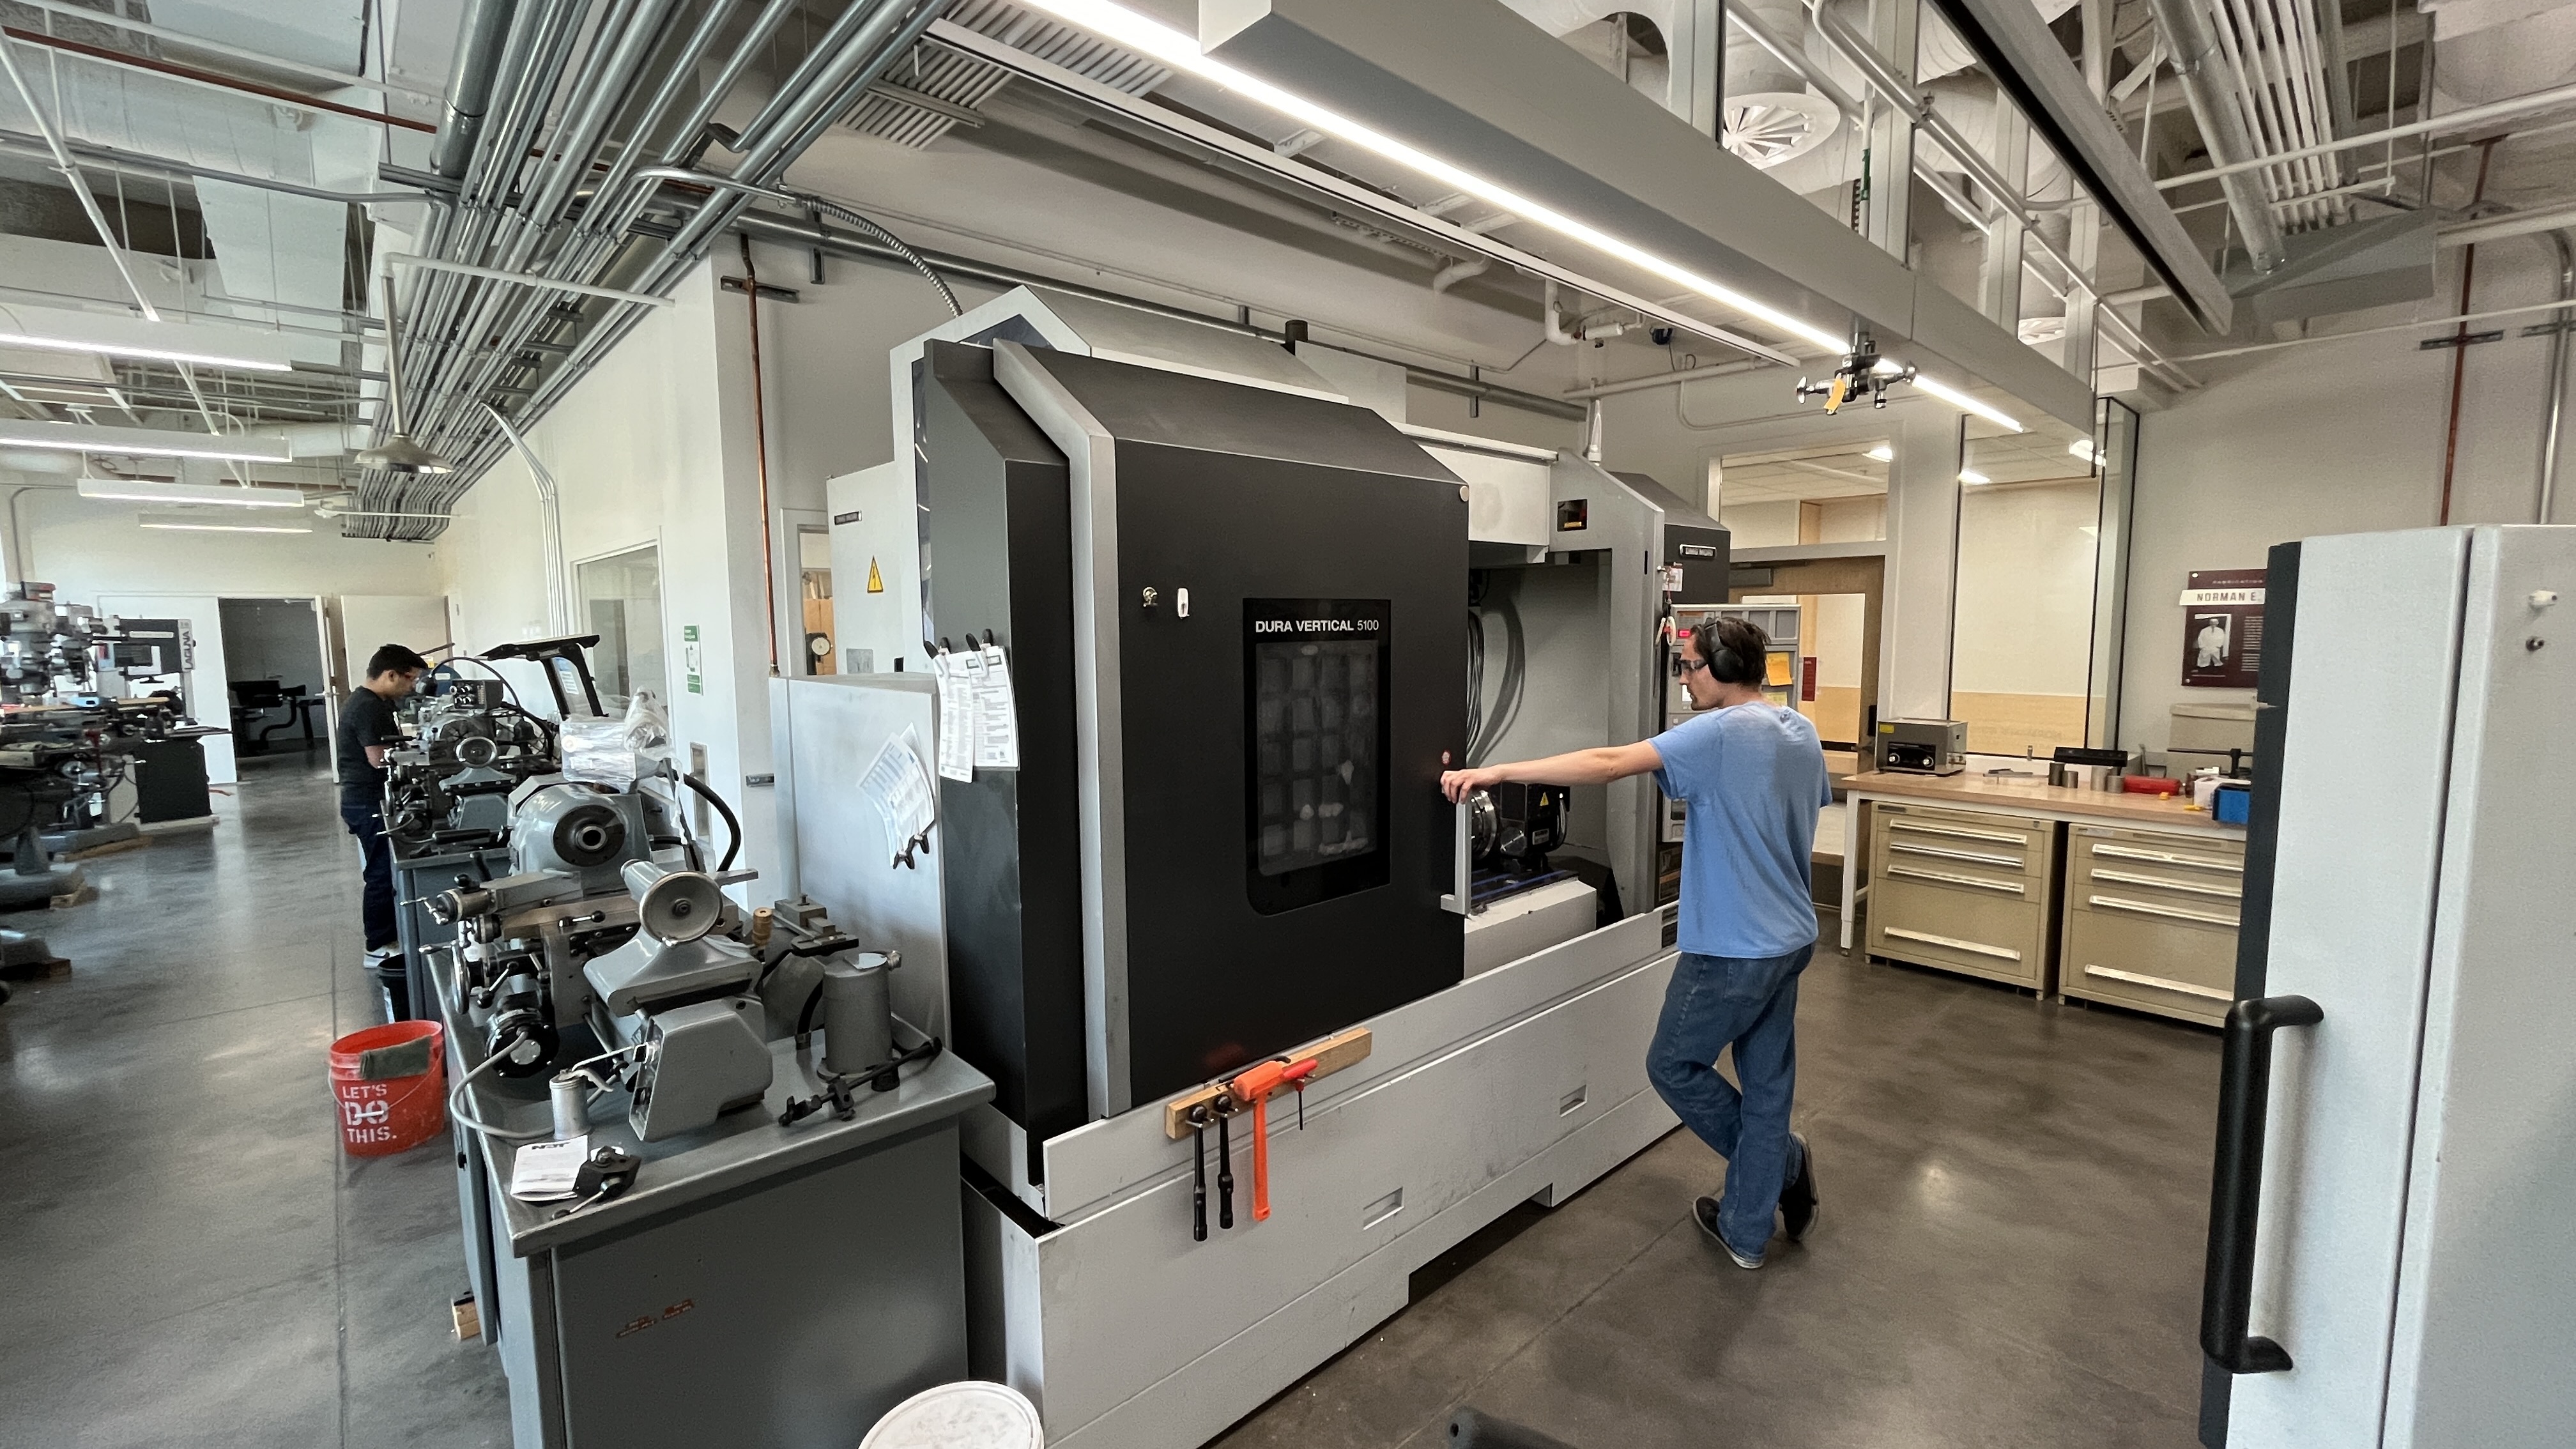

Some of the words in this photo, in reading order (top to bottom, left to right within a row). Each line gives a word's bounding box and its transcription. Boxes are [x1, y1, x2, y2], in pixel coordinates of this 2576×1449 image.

[2196, 592, 2246, 602] NORMAN
[1255, 620, 1293, 632] DURA
[1296, 620, 1354, 632] VERTICAL
[1356, 620, 1379, 631] 5100
[182, 631, 193, 670] LAGUNA
[342, 1084, 387, 1099] LET'S
[345, 1100, 389, 1126] DO
[346, 1126, 397, 1144] THIS.
